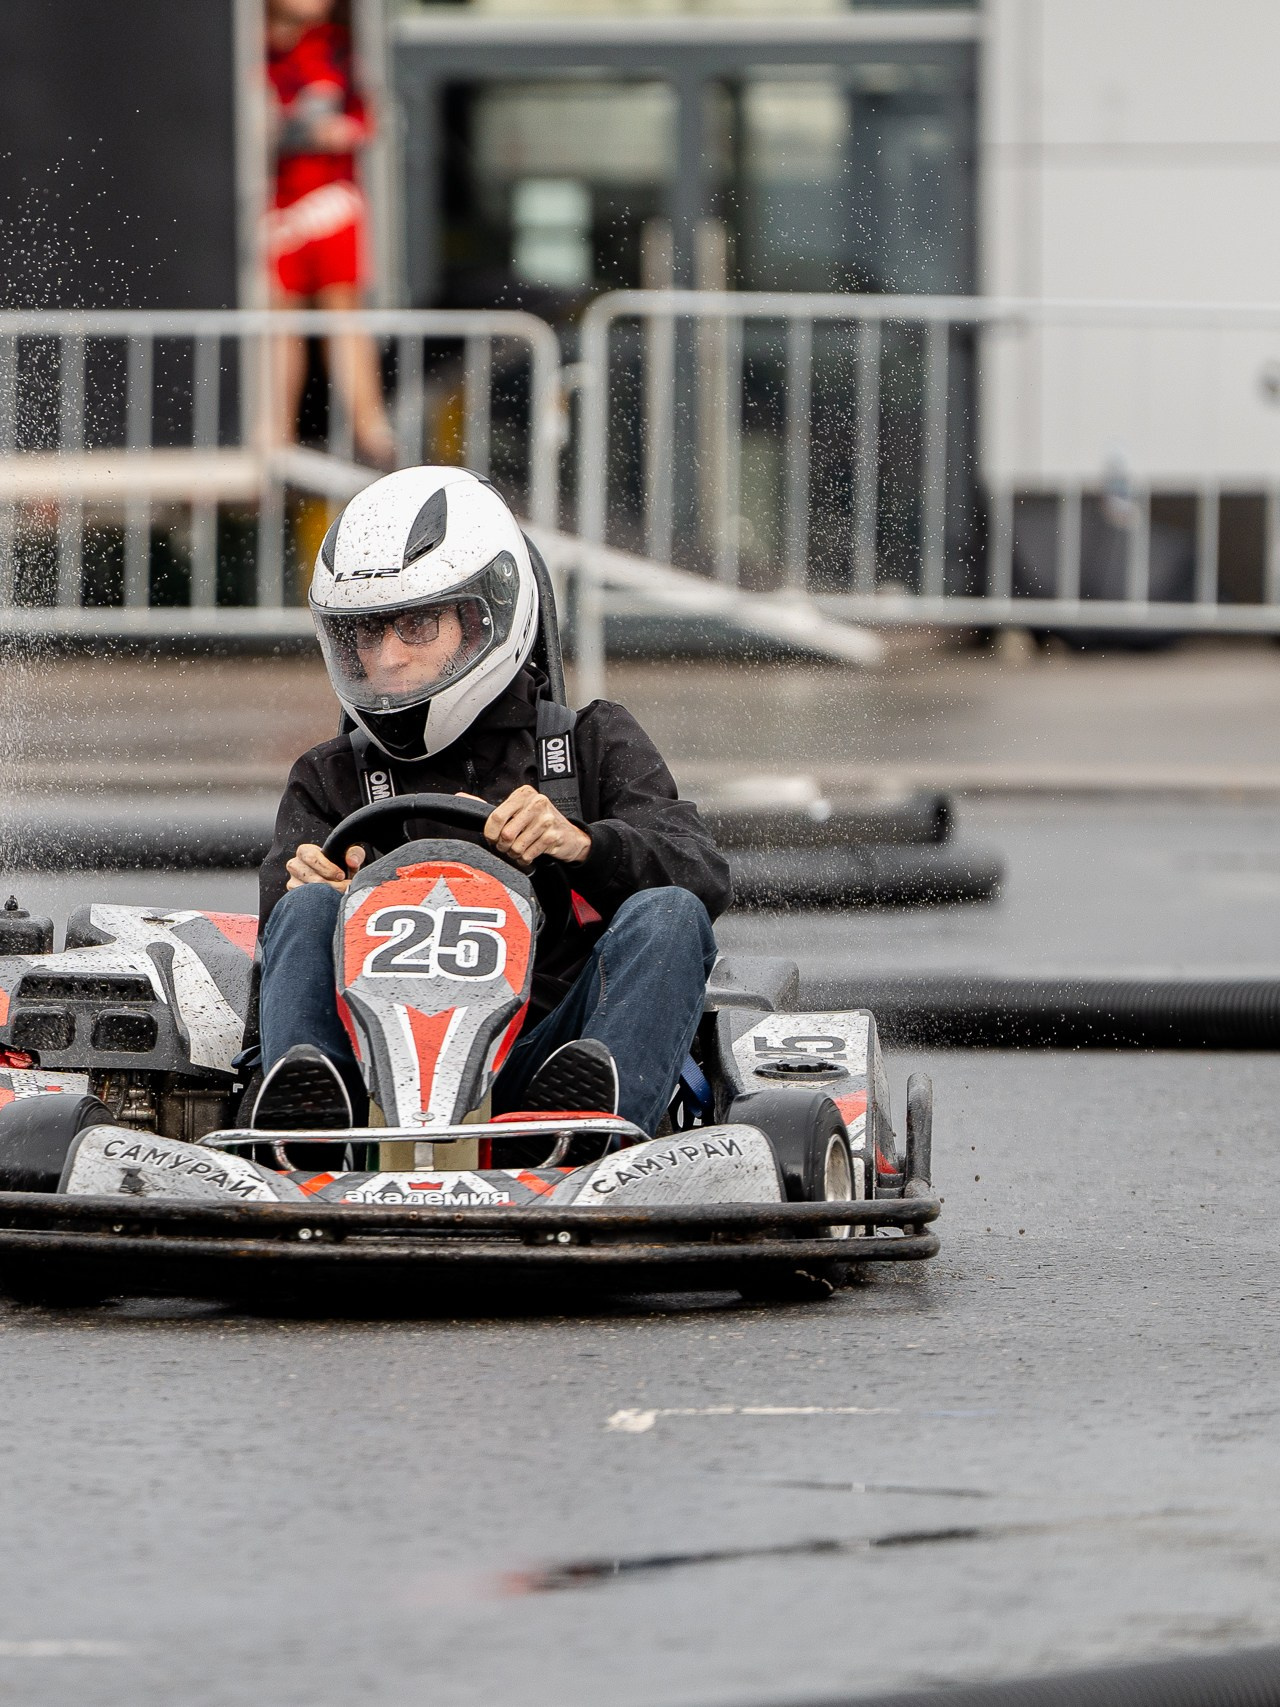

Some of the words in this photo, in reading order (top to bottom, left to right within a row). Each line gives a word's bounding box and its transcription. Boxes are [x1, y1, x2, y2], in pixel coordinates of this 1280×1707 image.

[334, 568, 402, 583] LS2
[546, 738, 567, 773] OMP
[370, 770, 391, 803] OM
[366, 907, 504, 980] 25
[103, 1139, 265, 1198] САМУРАЙ
[592, 1133, 744, 1195] САМУРАЙ
[345, 1190, 510, 1206] академия
